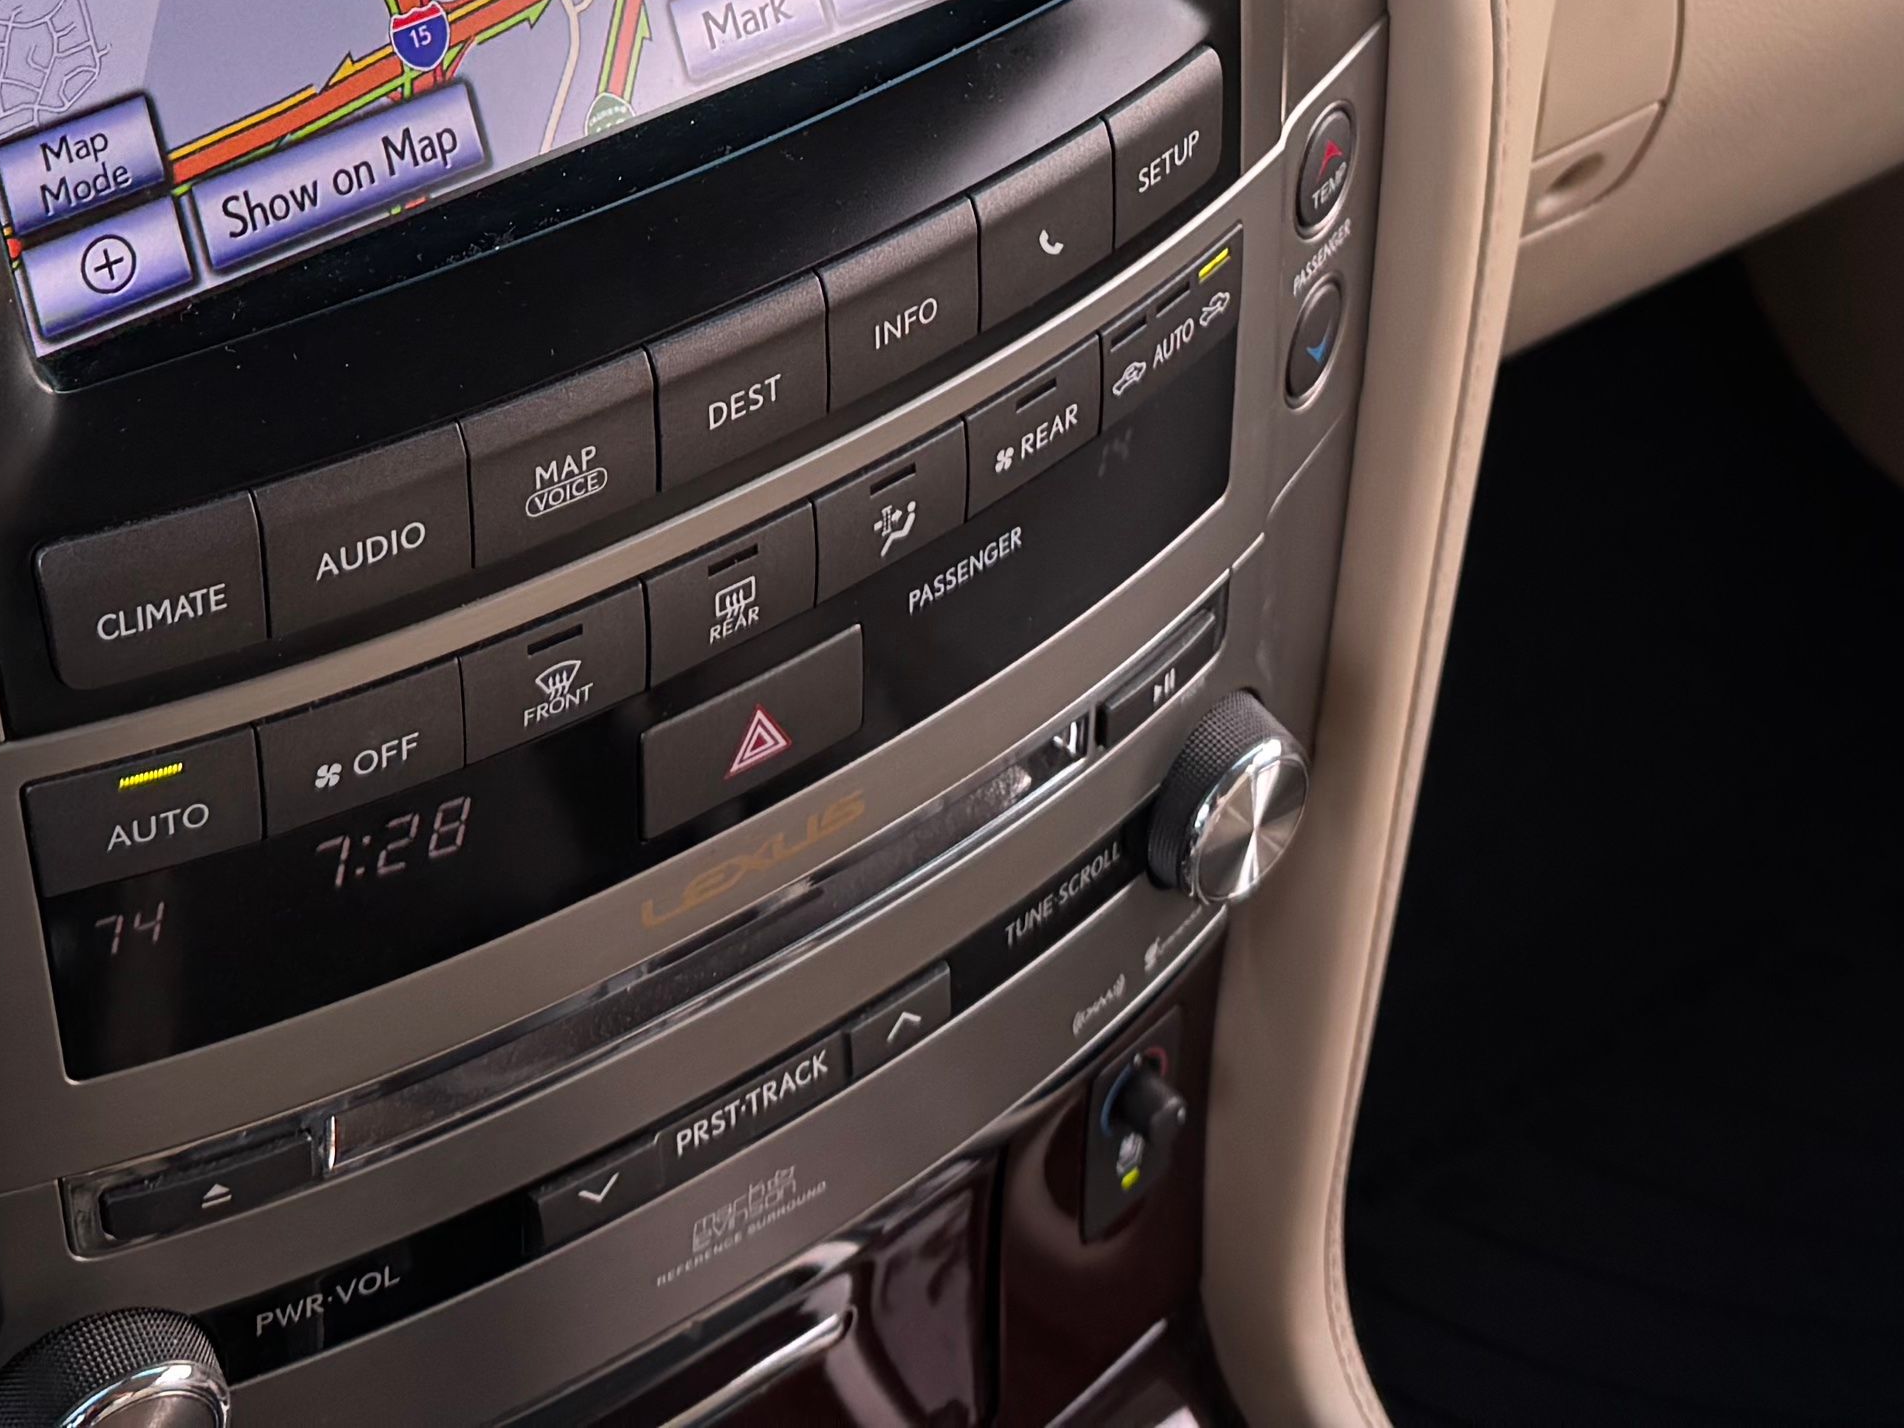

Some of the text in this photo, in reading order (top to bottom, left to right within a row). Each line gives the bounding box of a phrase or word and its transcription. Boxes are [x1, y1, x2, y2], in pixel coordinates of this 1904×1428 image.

[407, 24, 433, 49] 15
[39, 131, 109, 172] Map
[1136, 129, 1200, 194] SETUP
[39, 159, 133, 216] Mode
[221, 124, 458, 239] Show on Map
[1311, 160, 1348, 211] TEMP
[1293, 217, 1353, 297] PASSENGER
[872, 296, 939, 350] INFO
[1151, 317, 1195, 370] AUTO
[706, 373, 782, 431] DEST
[1019, 402, 1080, 460] REAR
[533, 445, 598, 490] MAP
[533, 474, 601, 513] VOICE
[314, 520, 427, 582] AUDIO
[906, 526, 1024, 617] PASSENGER
[95, 582, 229, 642] CLIMATE
[707, 604, 760, 645] REAR
[522, 681, 595, 728] FRONT
[352, 730, 421, 777] OFF
[106, 802, 210, 852] AUTO
[315, 795, 473, 890] 7:28
[640, 790, 868, 929] LEXUS
[94, 899, 167, 956] 74
